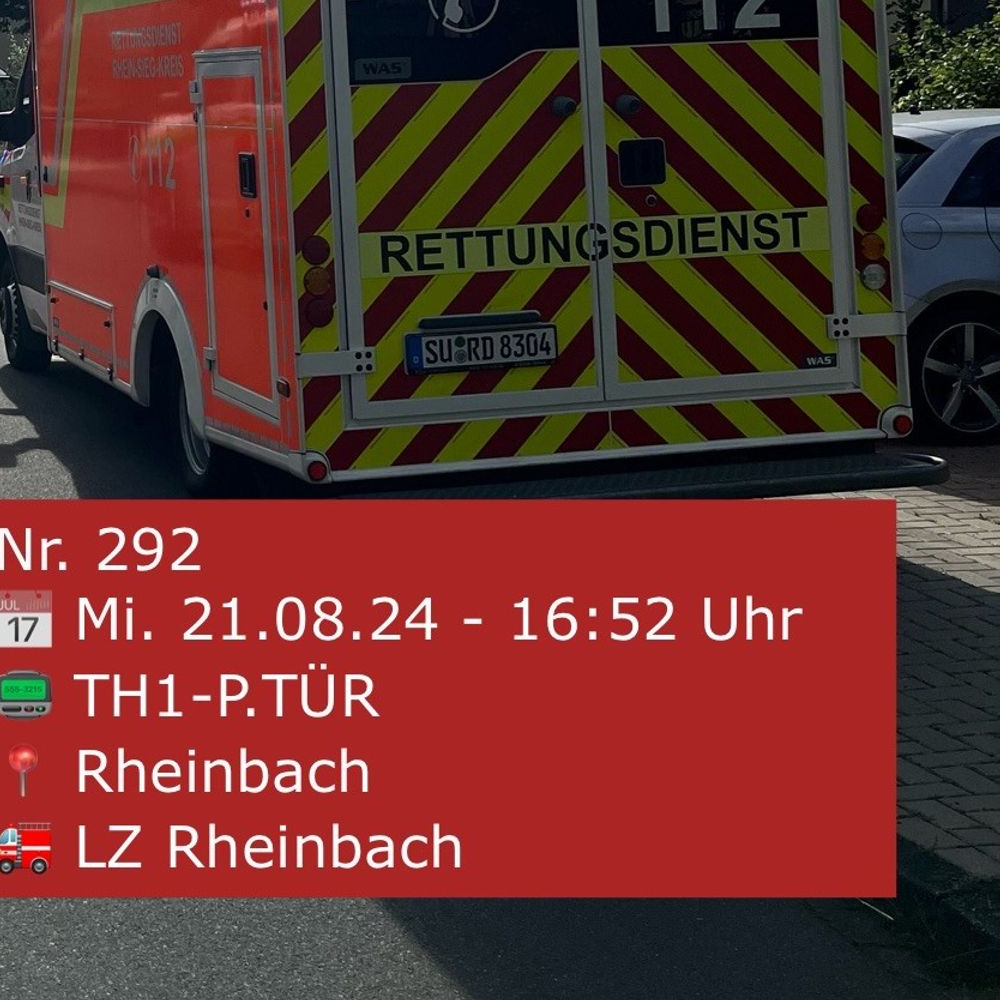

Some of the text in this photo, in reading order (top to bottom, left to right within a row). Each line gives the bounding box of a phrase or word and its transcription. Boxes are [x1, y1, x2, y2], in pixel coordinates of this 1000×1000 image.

[362, 62, 402, 75] WAS
[145, 135, 177, 190] 112
[381, 211, 808, 274] RETTUNGSDIENST
[425, 331, 552, 364] SU RD 8304
[806, 355, 832, 366] WAS
